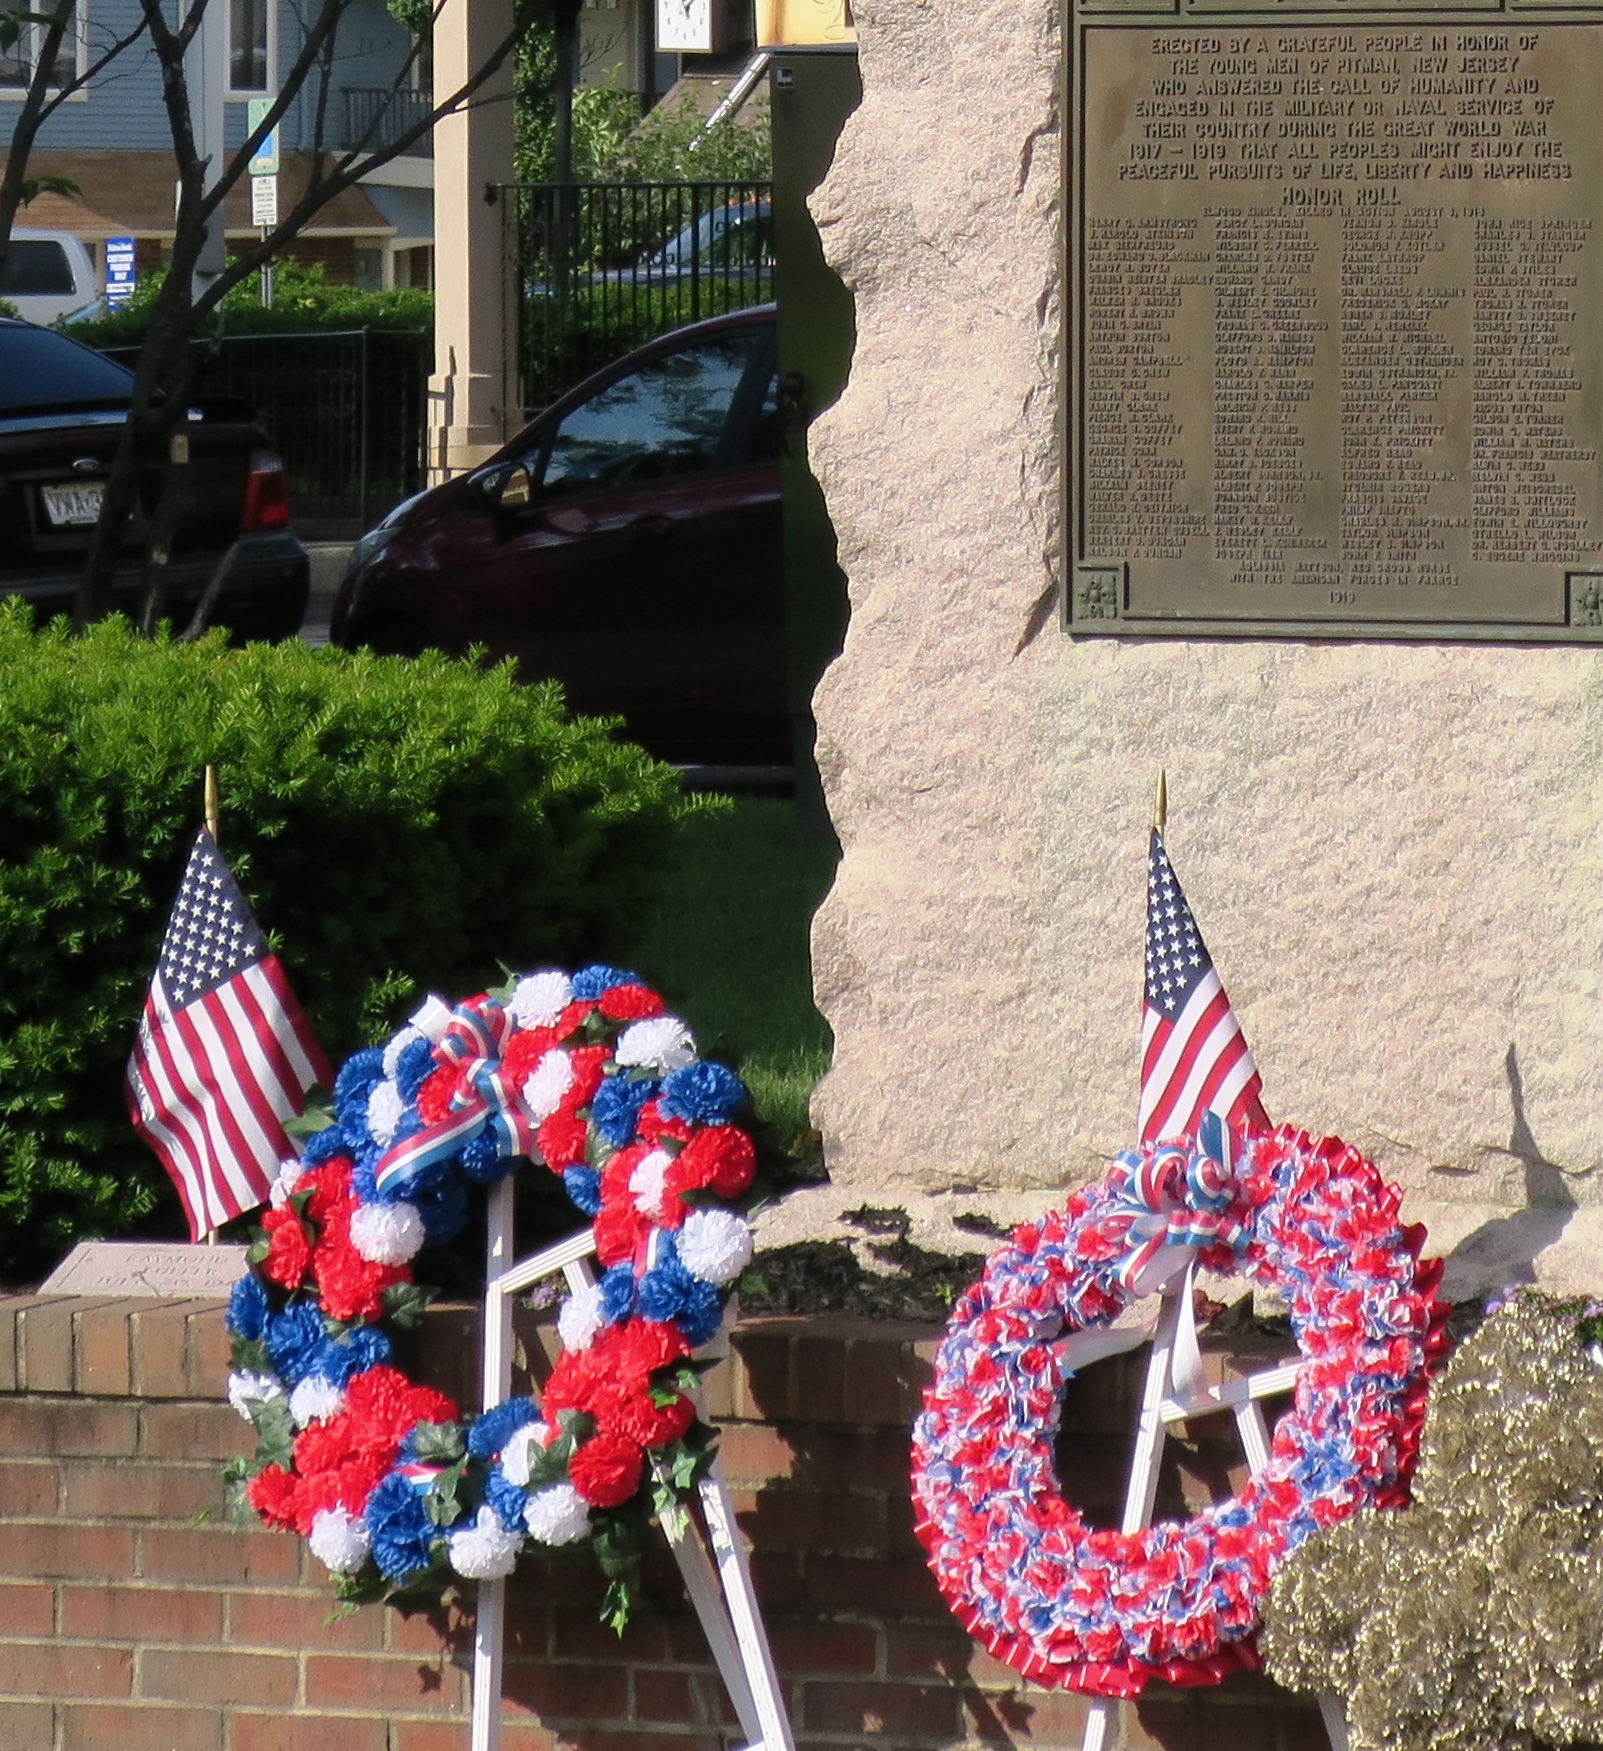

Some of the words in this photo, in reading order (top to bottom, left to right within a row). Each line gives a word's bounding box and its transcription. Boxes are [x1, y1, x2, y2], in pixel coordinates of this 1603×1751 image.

[1152, 38, 1220, 53] ERECTED
[1230, 38, 1250, 53] BY
[1257, 38, 1268, 52] A
[1278, 36, 1356, 51] GRATEFUL
[1365, 35, 1423, 51] PEOPLE
[1432, 36, 1447, 50] IN
[1457, 36, 1508, 50] HONOR
[1519, 35, 1538, 50] OF
[1170, 59, 1198, 74] THE
[1209, 59, 1256, 74] YOUNG
[1267, 59, 1298, 74] MEN
[1310, 59, 1329, 73] OF
[1338, 58, 1400, 75] PITMAN,
[1413, 57, 1447, 73] NEW
[1457, 57, 1520, 73] JERSEY
[1153, 80, 1186, 95] WHO
[1197, 80, 1282, 95] ANSWERED
[1290, 80, 1319, 94] THE
[1330, 79, 1371, 94] CALL
[1381, 79, 1400, 94] OF
[1410, 79, 1496, 94] HUMANITY
[1504, 79, 1538, 93] AND
[1135, 101, 1208, 116] ENGAGED
[1220, 101, 1234, 116] IN
[1243, 101, 1273, 116] THE
[1284, 101, 1354, 116] MILITARY
[1363, 101, 1383, 116] OR
[1396, 100, 1446, 116] NAVAL
[1456, 100, 1522, 115] SERVICE
[1535, 99, 1554, 115] OF
[1143, 122, 1186, 138] THEIR
[1195, 122, 1270, 138] COUNTRY
[1278, 122, 1336, 137] DURING
[1345, 122, 1374, 137] THE
[1384, 122, 1434, 137] GREAT
[1445, 121, 1501, 137] WORLD
[1512, 121, 1547, 136] WAR
[1130, 144, 1161, 159] 1917
[1193, 144, 1225, 159] 1919
[1238, 144, 1277, 159] THAT
[1287, 143, 1319, 158] ALL
[1329, 143, 1399, 158] PEOPLES
[1411, 143, 1460, 158] MIGHT
[1470, 142, 1523, 158] ENJOY
[1532, 142, 1562, 158] THE
[1119, 165, 1198, 180] PEACEFUL
[1208, 164, 1283, 180] PURSUITS
[1292, 164, 1312, 179] OF
[1321, 164, 1358, 181] LIFE,
[1366, 164, 1432, 179] LIBERTY
[1439, 164, 1473, 179] AND
[1483, 163, 1571, 179] HAPPINESS
[1282, 188, 1342, 205] HONOR
[1356, 187, 1401, 205] ROLL
[1296, 207, 1333, 217] KILLED
[1341, 207, 1350, 217] IN
[1359, 207, 1396, 217] ACTION
[1404, 207, 1444, 217] AUGUST
[1291, 575, 1340, 584] AMERICAN
[1418, 576, 1459, 586] FRANCE
